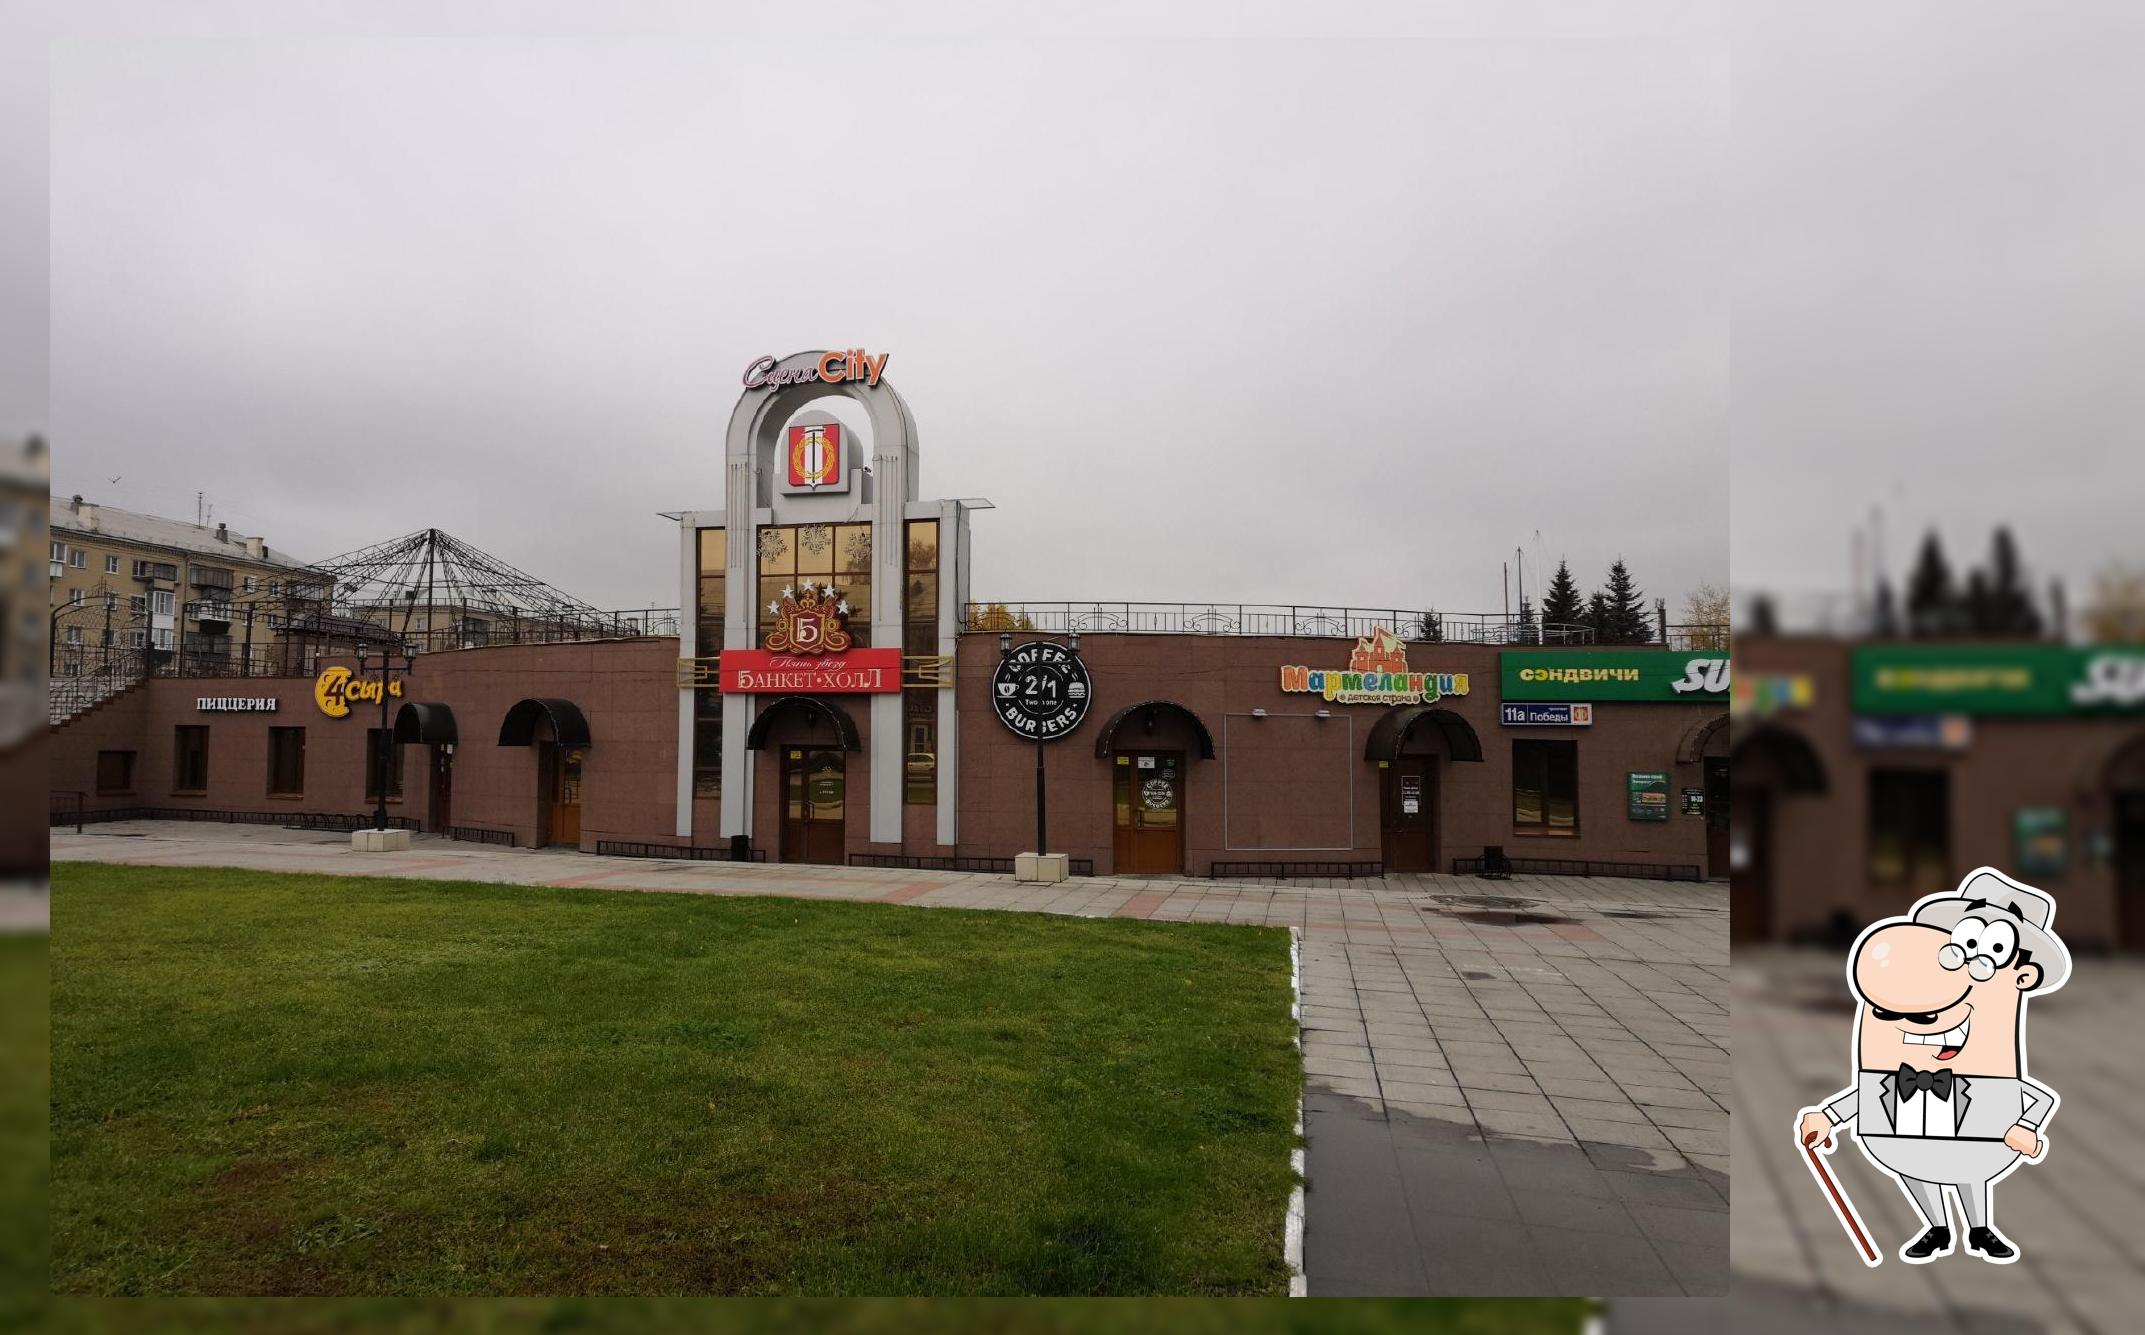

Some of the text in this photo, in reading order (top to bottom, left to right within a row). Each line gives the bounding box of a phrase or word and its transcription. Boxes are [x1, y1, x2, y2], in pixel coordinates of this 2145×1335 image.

[818, 348, 889, 386] City
[1282, 666, 1470, 702] Мармеландия
[197, 697, 276, 712] ПИЦЦЕРИЯ
[1504, 707, 1569, 722] 11а Победы
